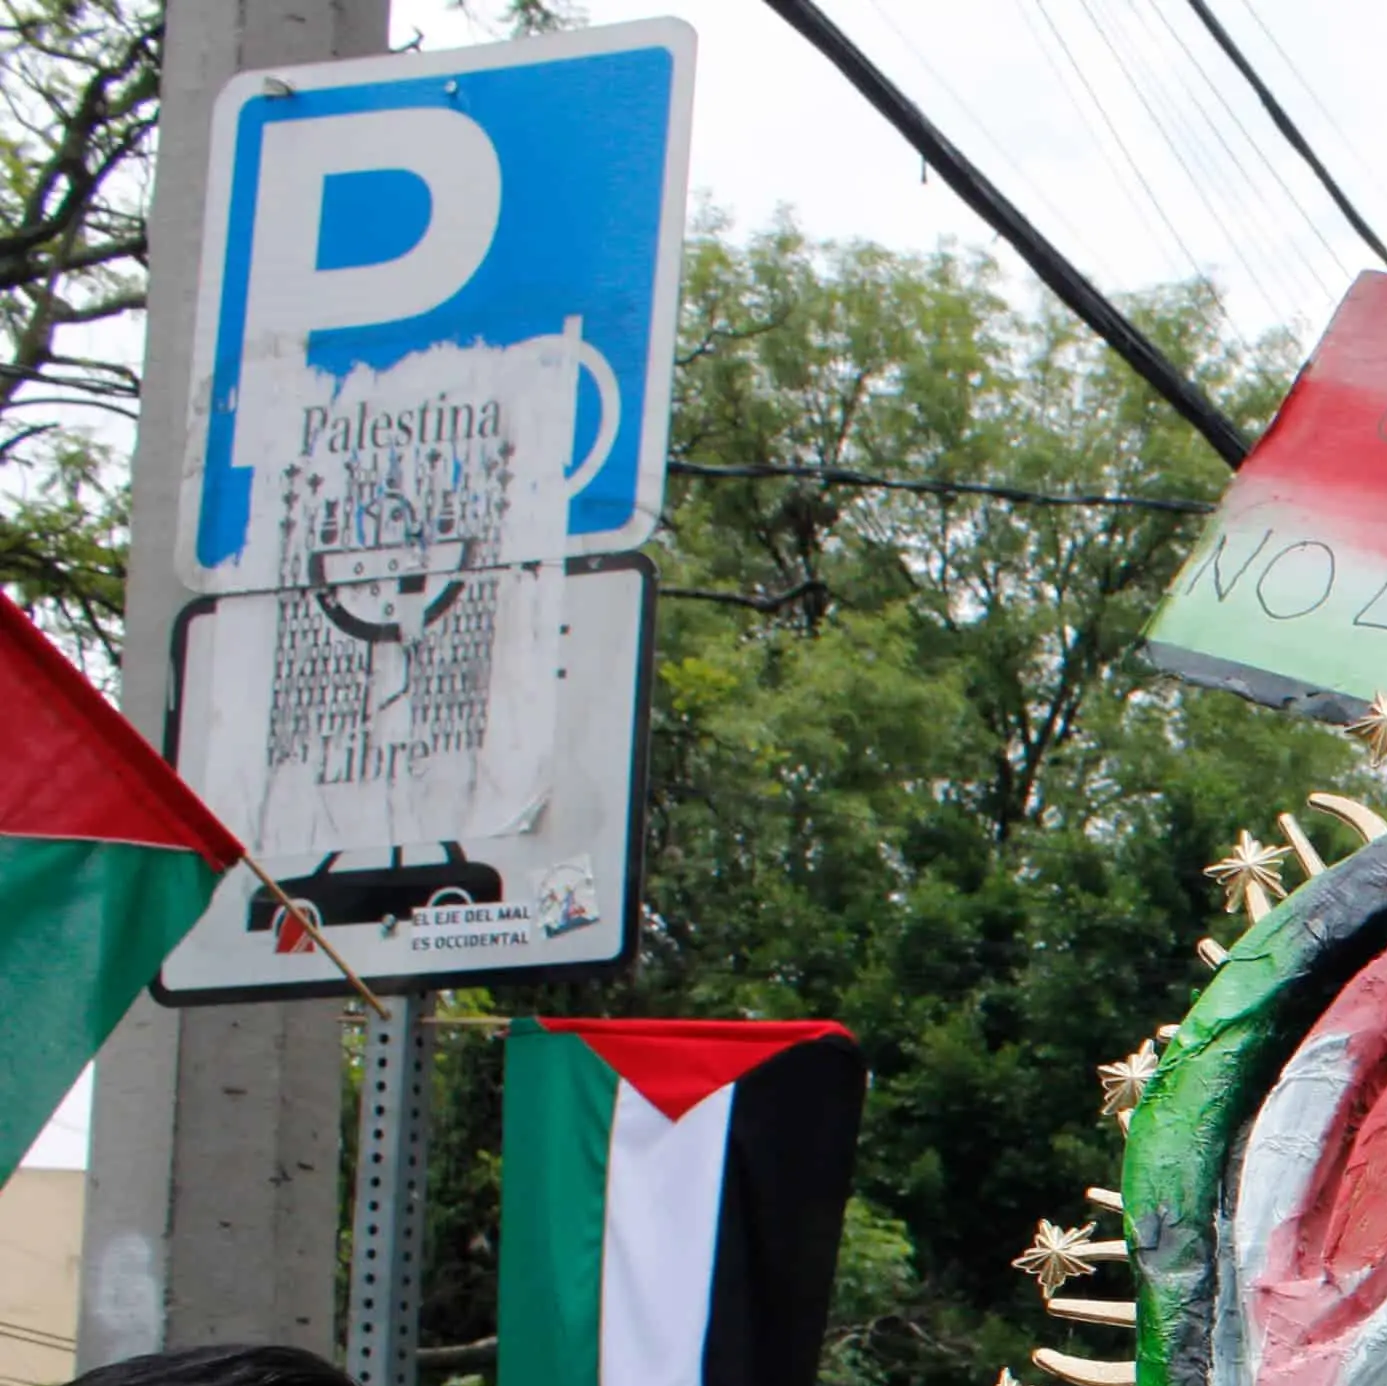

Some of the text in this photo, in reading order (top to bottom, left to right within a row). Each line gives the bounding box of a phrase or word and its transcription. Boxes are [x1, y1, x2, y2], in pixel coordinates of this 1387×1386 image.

[231, 106, 502, 467] P
[301, 392, 501, 457] Palestina
[1186, 528, 1335, 620] NO
[316, 733, 430, 787] Libre
[412, 906, 531, 927] EL EJE DEL MAL
[412, 932, 529, 951] ES OCCIDENTAL
